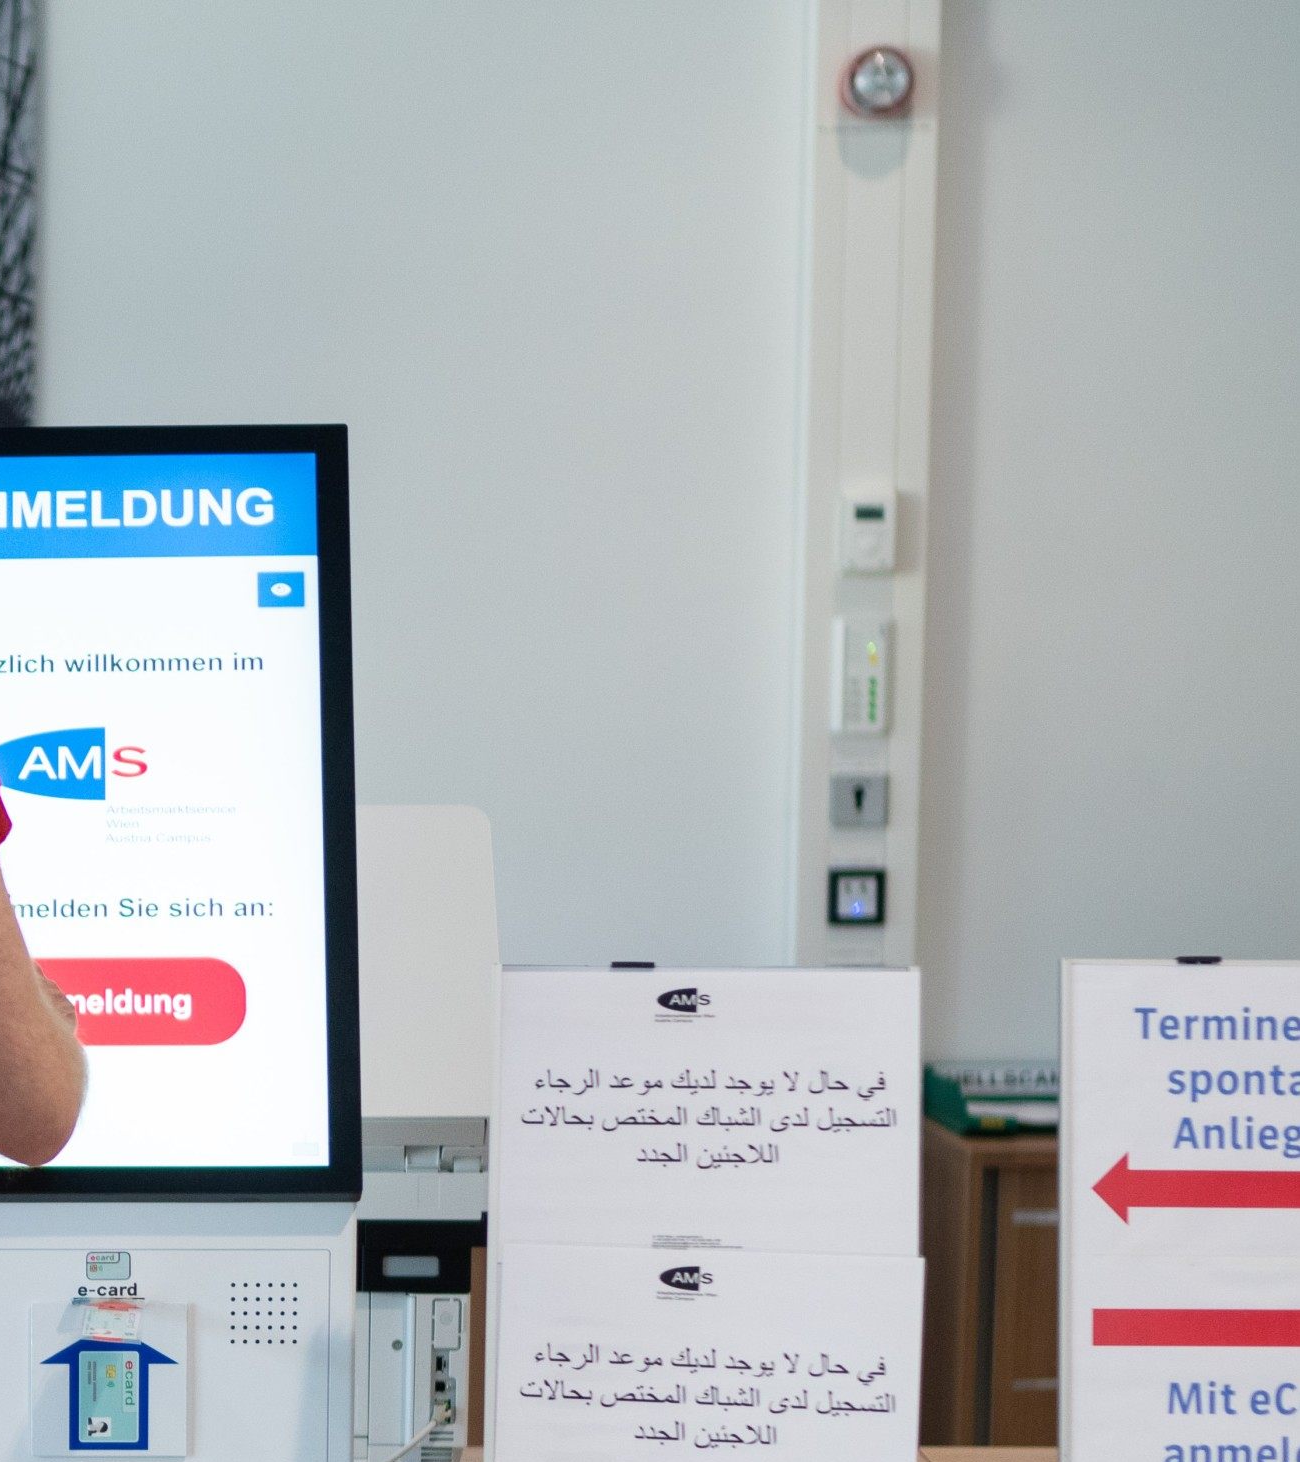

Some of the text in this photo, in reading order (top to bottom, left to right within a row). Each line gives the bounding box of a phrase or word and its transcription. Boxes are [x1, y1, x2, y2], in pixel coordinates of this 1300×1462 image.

[64, 653, 222, 673] willkommen
[234, 652, 263, 671] im
[17, 744, 148, 781] AMS
[105, 803, 238, 816] Arbeitsmarktservice
[105, 817, 140, 829] Wien
[118, 897, 159, 918] Sie
[168, 897, 223, 917] sich
[233, 899, 274, 917] an:
[65, 987, 192, 1021] meldung
[1134, 1006, 1300, 1041] Termine
[534, 1068, 887, 1102] في حال لا يوجد لديك موعد الرجاء
[519, 1105, 897, 1134] التسجيل لدى الشباك المختص بحالات
[1173, 1116, 1300, 1159] Anlieg
[636, 1142, 688, 1168] الجدد
[77, 1282, 138, 1297] e-card
[534, 1342, 887, 1387] في حال لا يوجد لديك موعد الرجاء
[519, 1380, 896, 1418] التسجيل لدى الشباك المختص بحالات
[1168, 1381, 1297, 1415] Mit eC
[633, 1421, 686, 1446] الجدد
